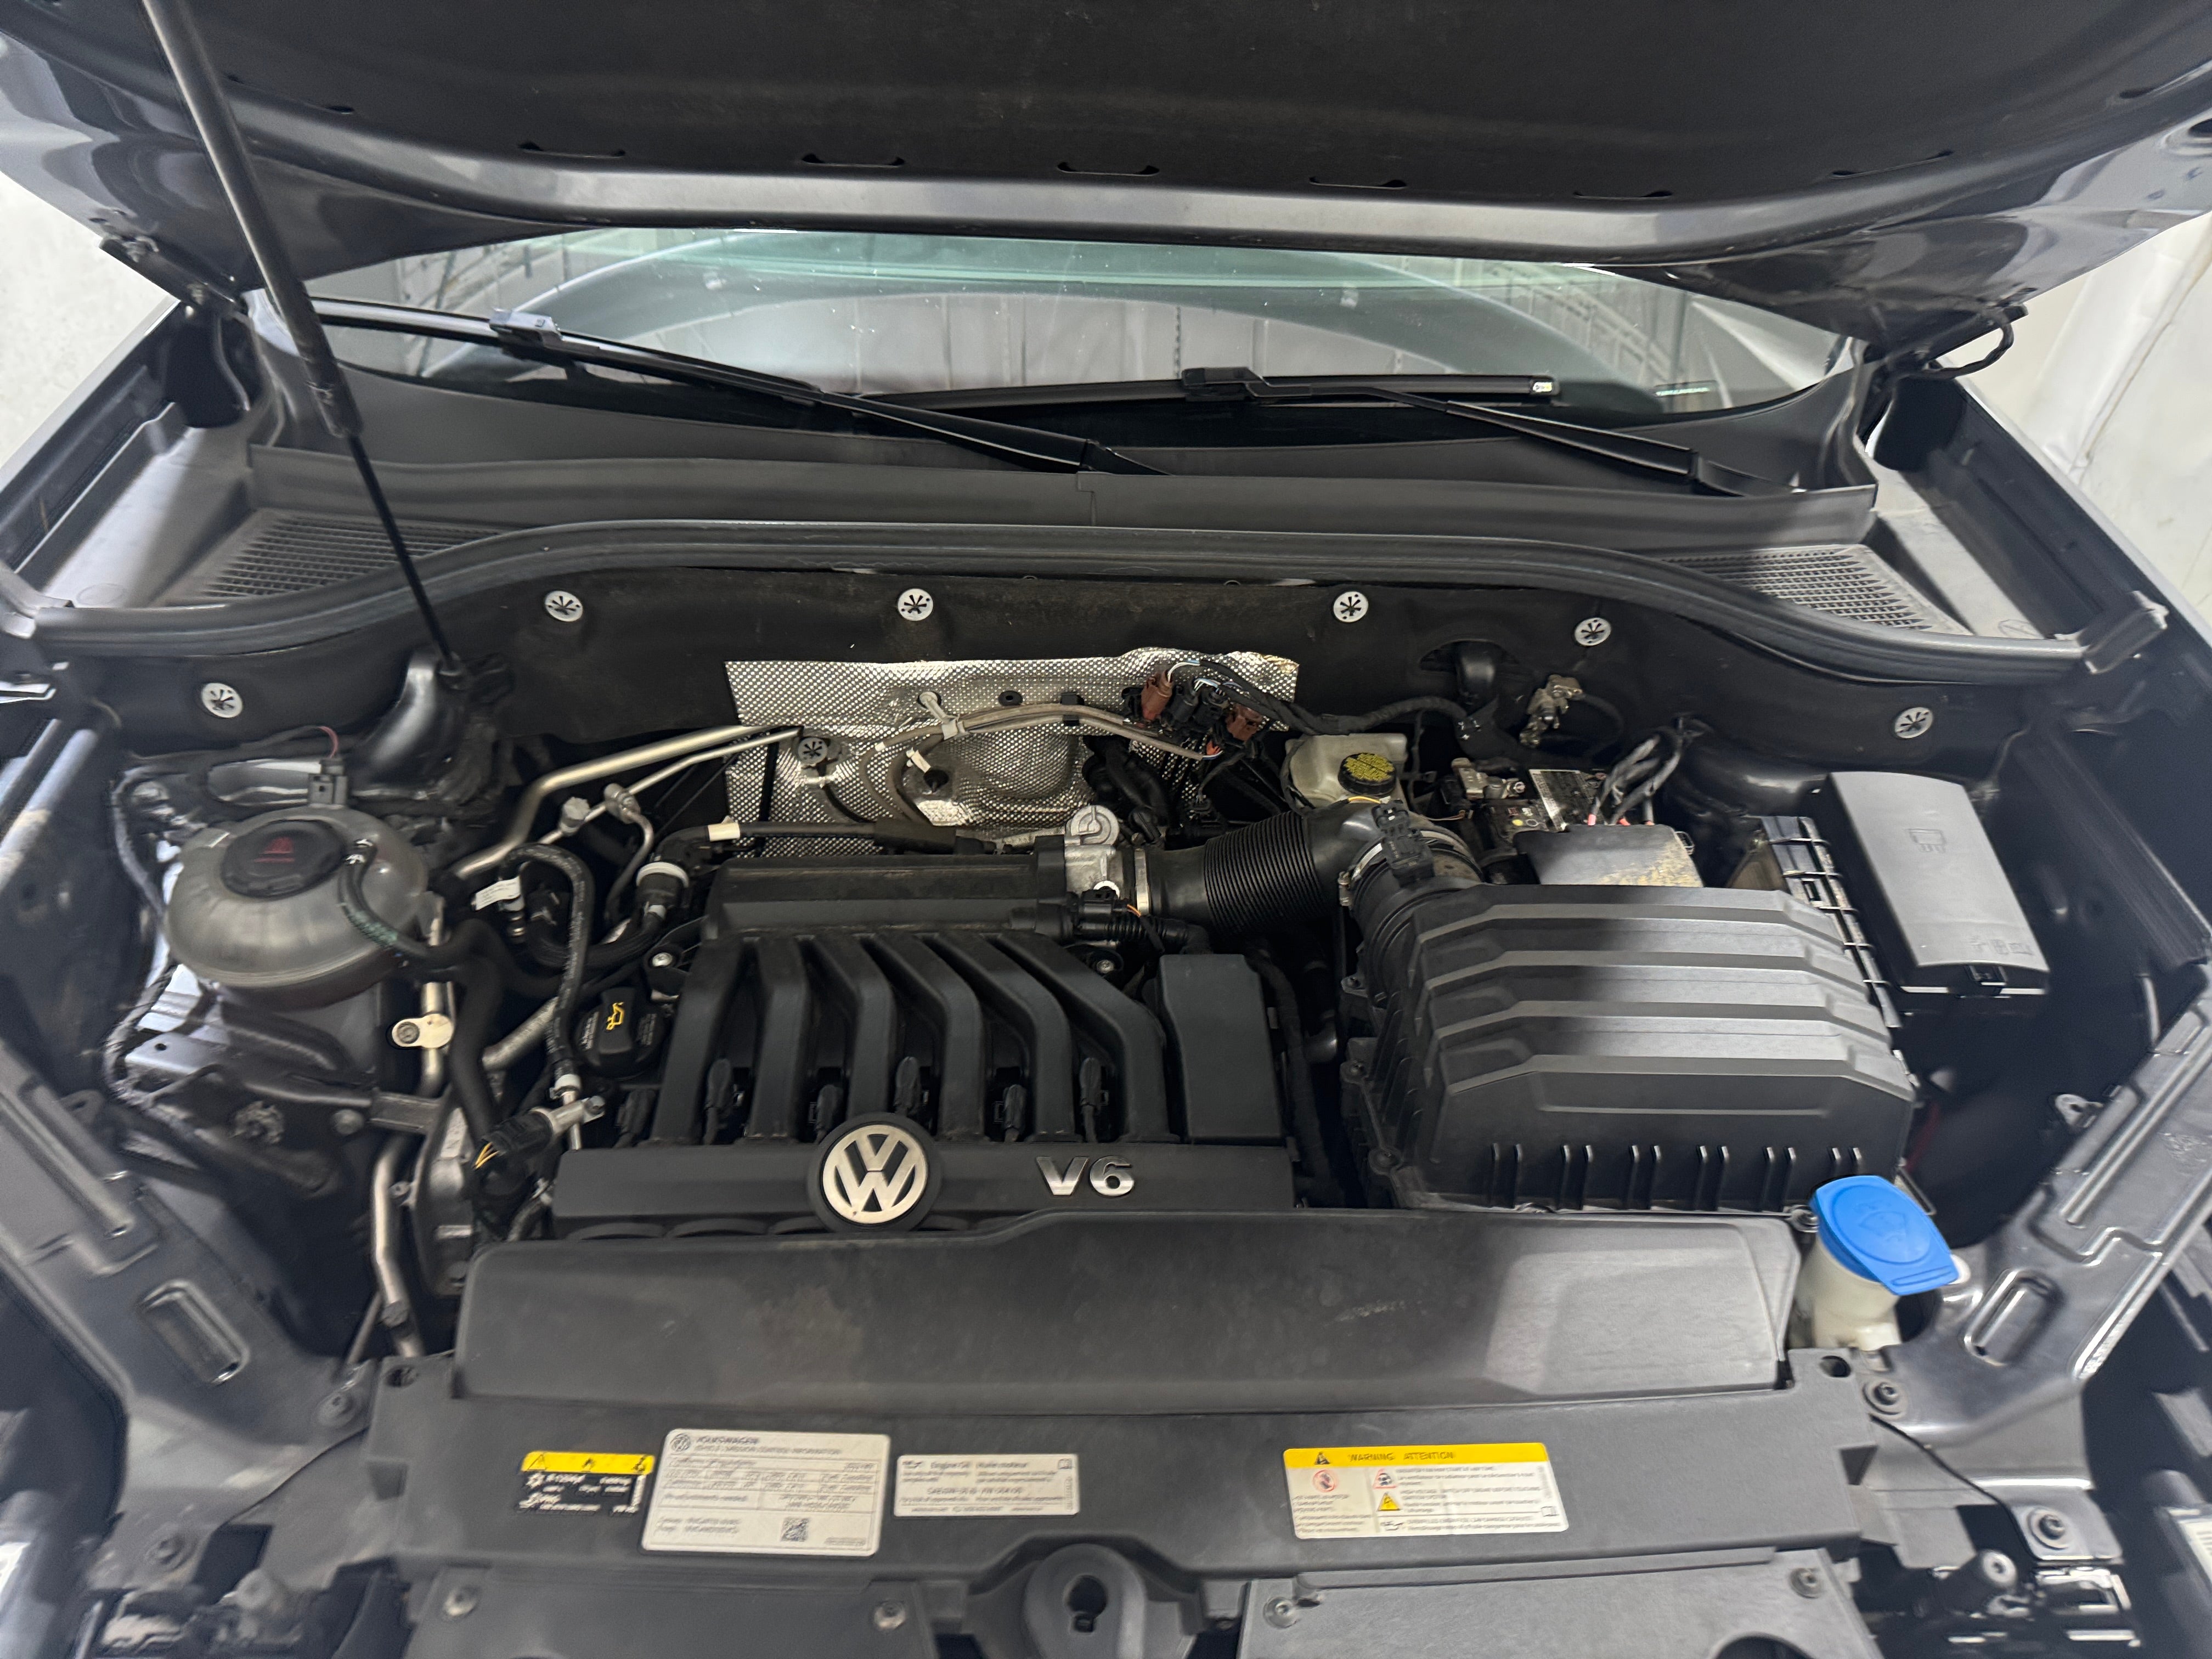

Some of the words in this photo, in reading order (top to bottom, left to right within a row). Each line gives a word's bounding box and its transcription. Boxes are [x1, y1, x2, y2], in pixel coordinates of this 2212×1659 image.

[822, 1124, 928, 1224] VW
[1036, 1155, 1135, 1197] V6
[1347, 1453, 1395, 1462] WARNING
[1403, 1451, 1455, 1460] ATTENTION
